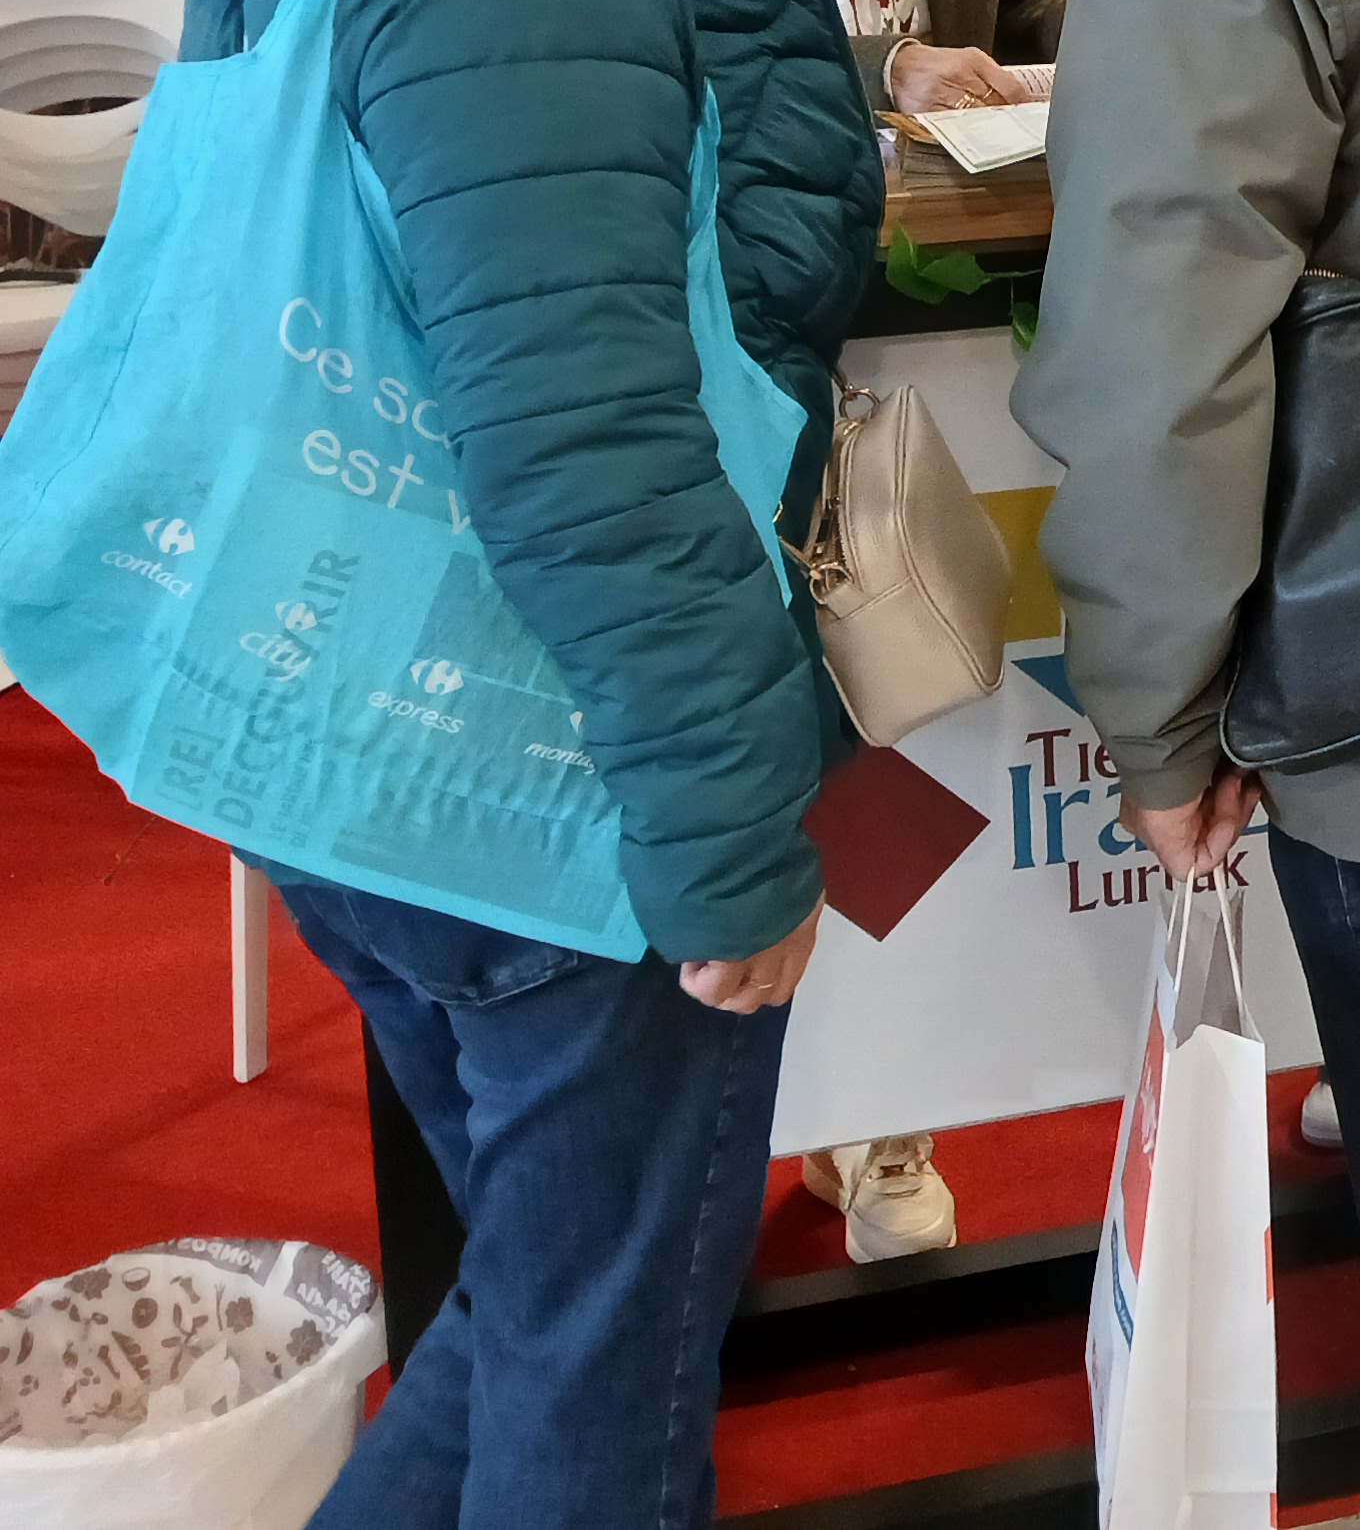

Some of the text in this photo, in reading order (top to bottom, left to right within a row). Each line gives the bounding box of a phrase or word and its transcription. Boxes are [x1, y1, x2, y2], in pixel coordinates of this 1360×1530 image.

[280, 297, 353, 394] Ce
[302, 429, 425, 509] est
[101, 550, 193, 600] contact
[239, 631, 314, 682] city
[367, 690, 465, 733] express
